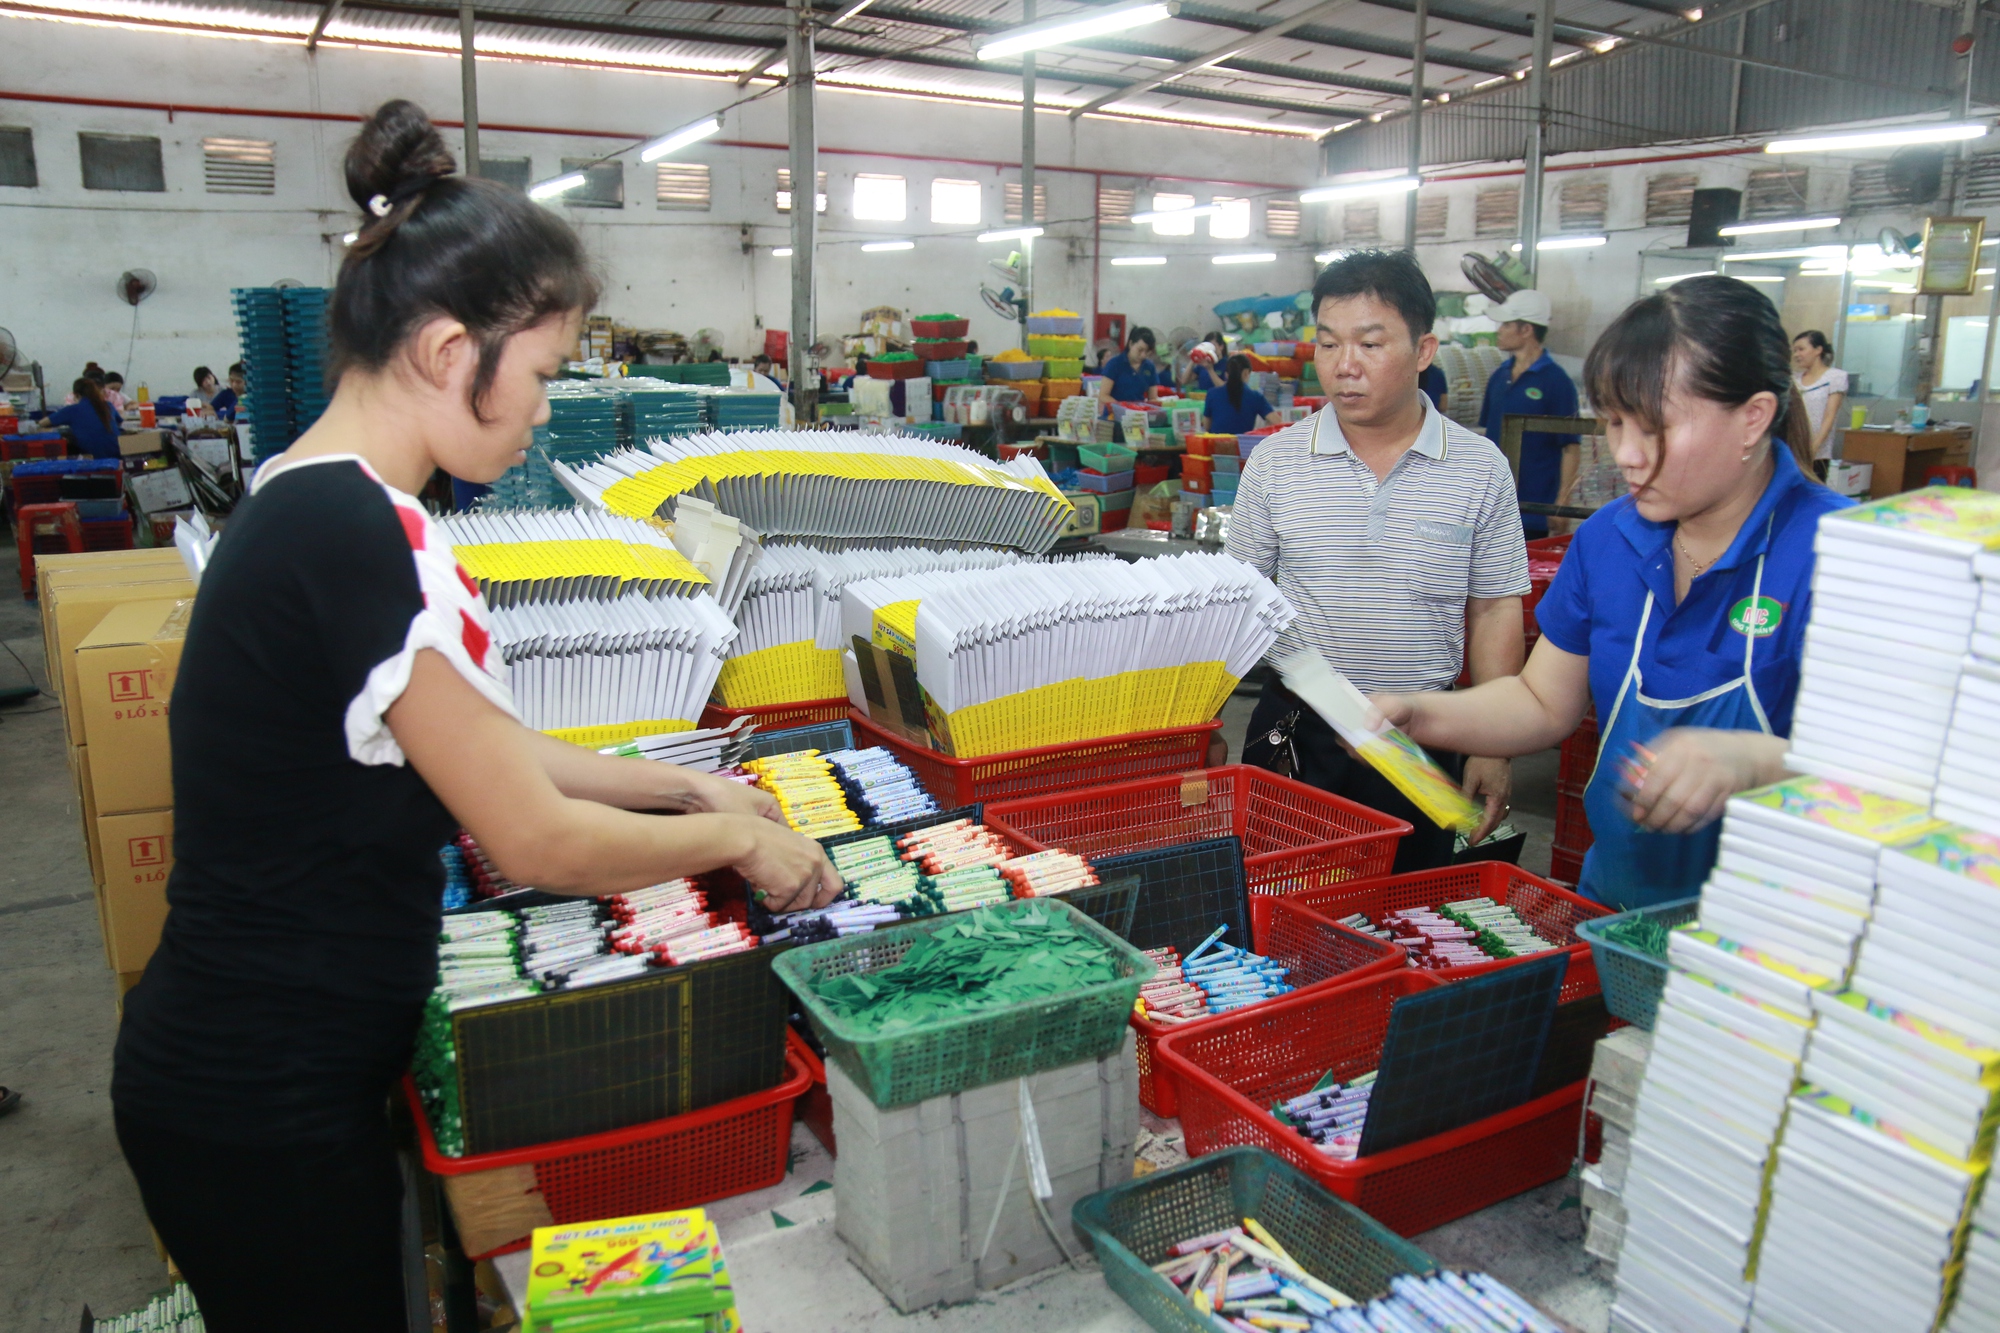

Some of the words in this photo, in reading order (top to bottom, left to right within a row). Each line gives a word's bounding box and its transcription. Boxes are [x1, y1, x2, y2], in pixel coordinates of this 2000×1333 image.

[114, 710, 123, 720] 9
[134, 874, 143, 884] 9
[607, 1237, 639, 1249] 999
